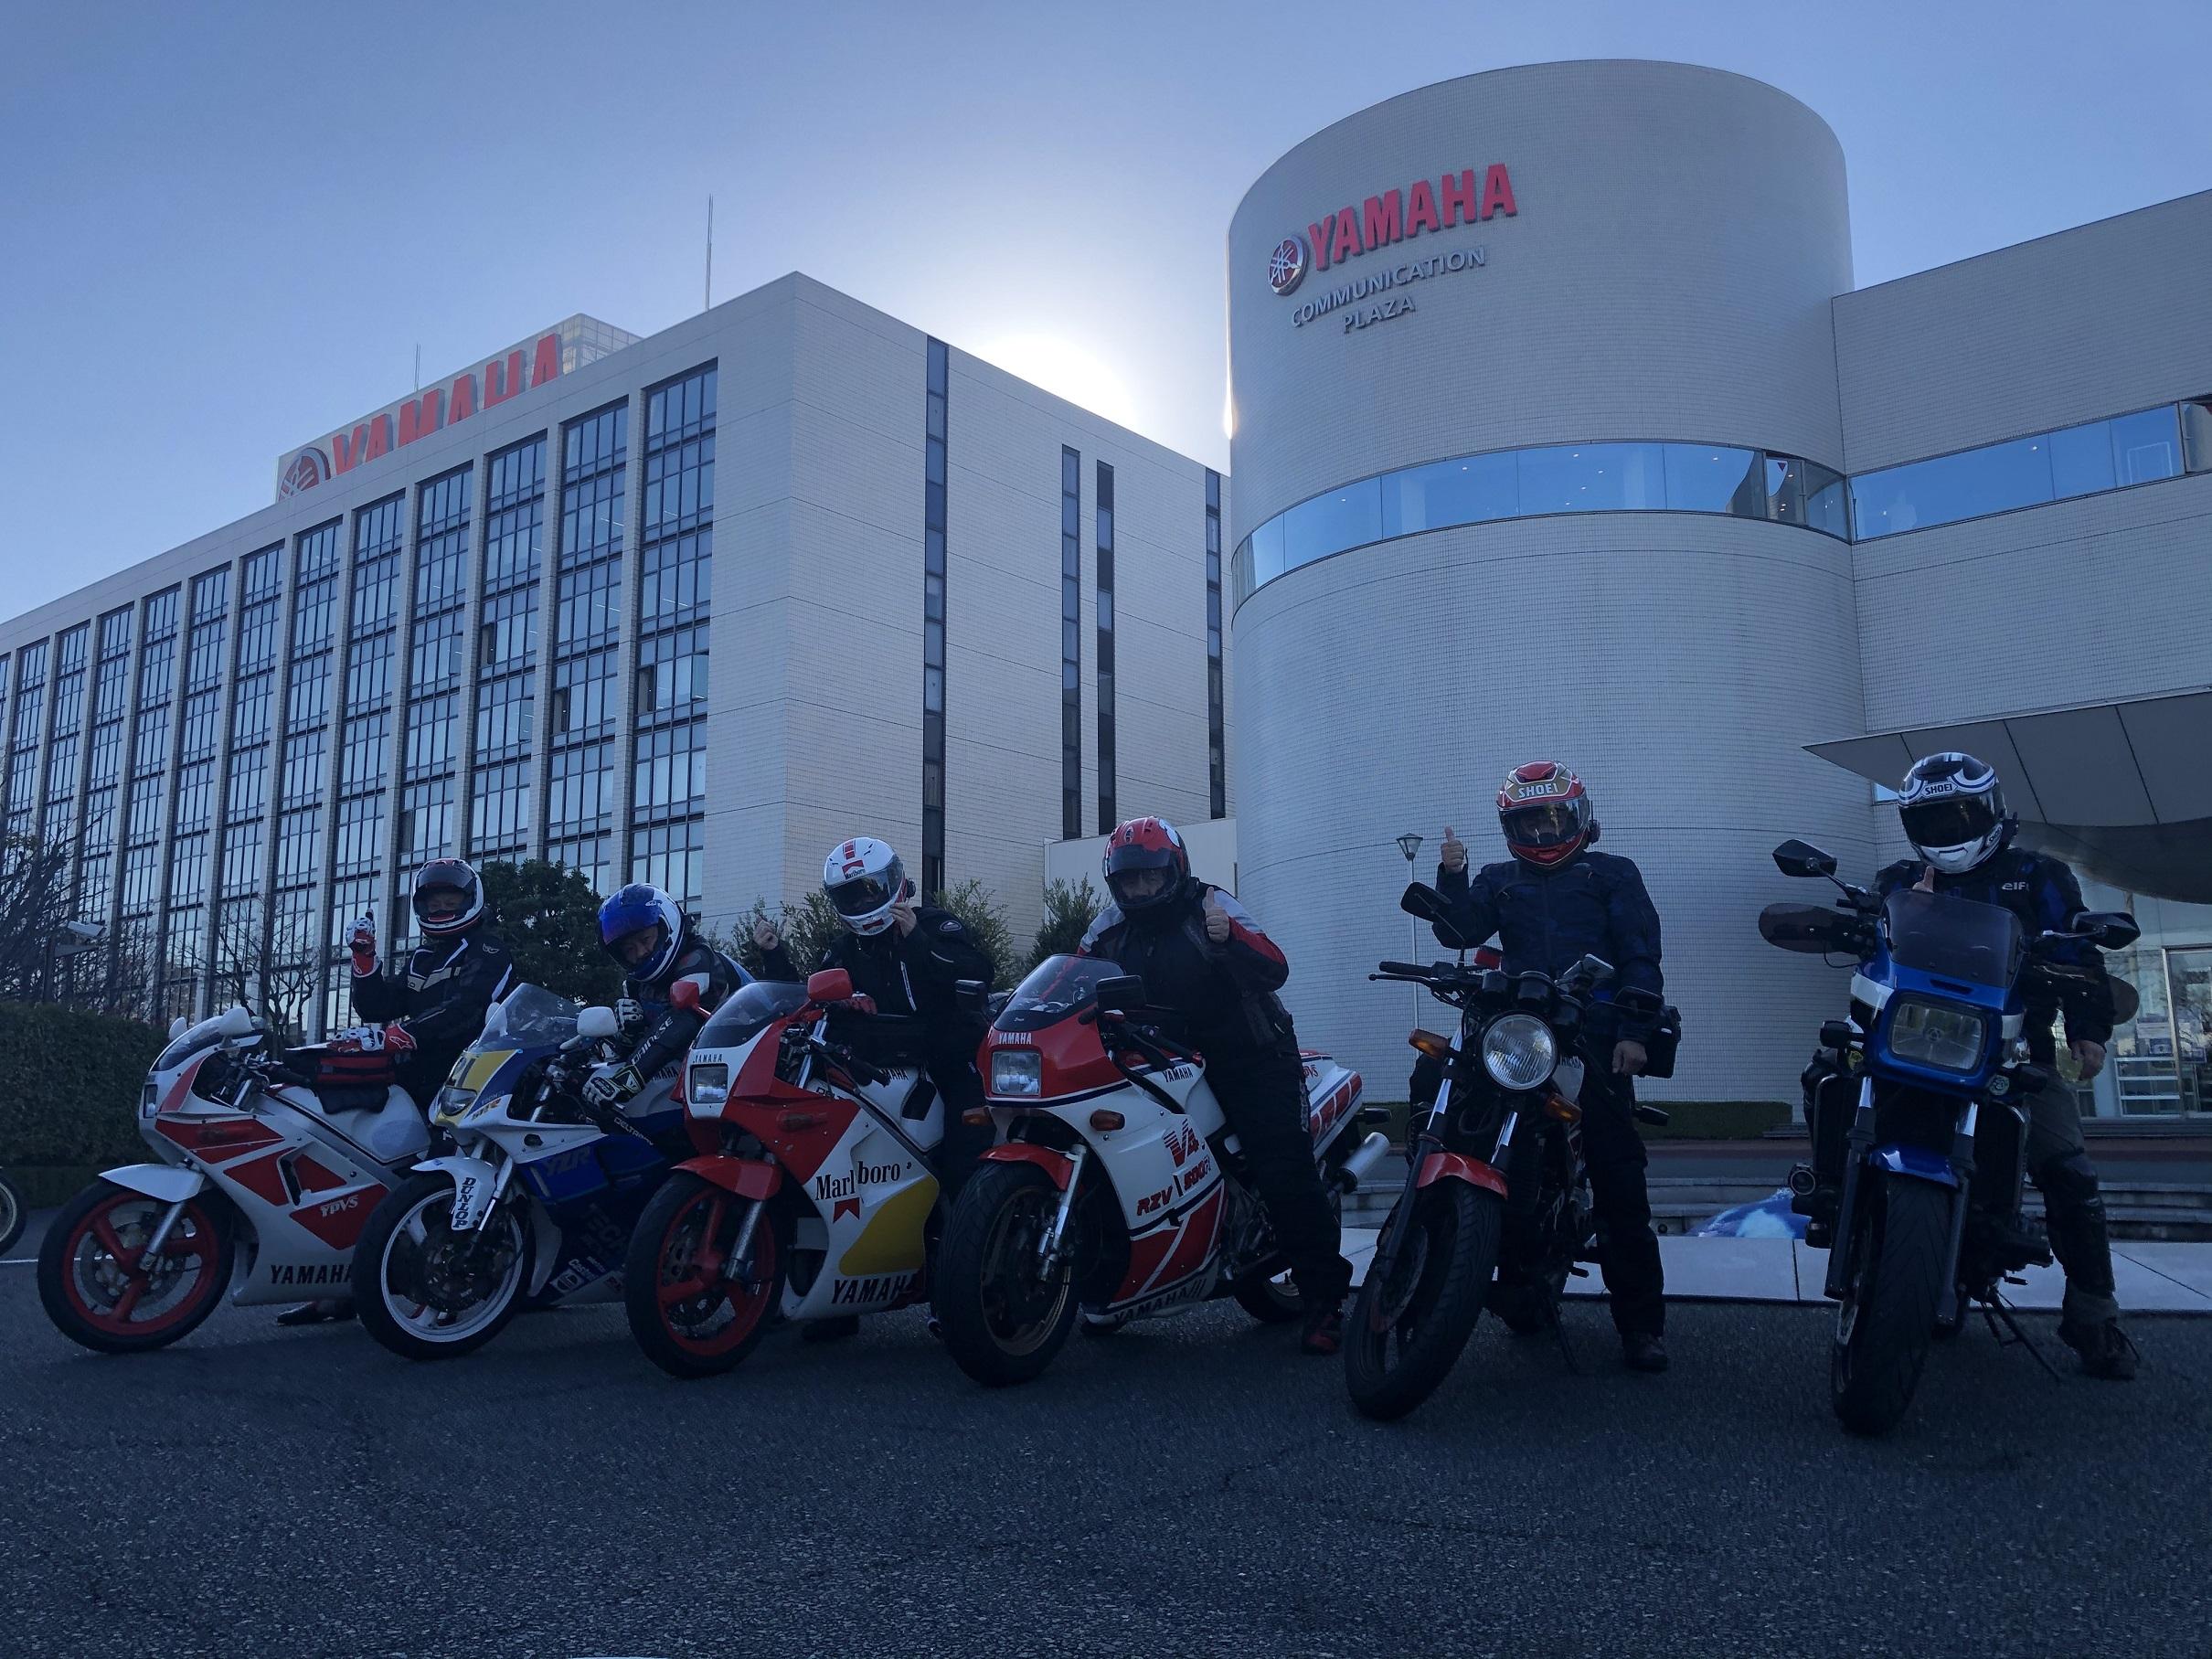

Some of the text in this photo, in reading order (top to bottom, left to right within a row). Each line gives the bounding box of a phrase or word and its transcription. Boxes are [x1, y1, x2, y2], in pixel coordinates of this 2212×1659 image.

[1308, 163, 1517, 271] YAMAHA
[1291, 247, 1485, 327] COMMUNICATION
[1344, 296, 1416, 333] PLAZA
[1518, 782, 1558, 799] SHOEI
[1925, 783, 1952, 795] SHOEI
[845, 868, 867, 880] Marlboro
[630, 1016, 675, 1066] DAINESE
[999, 1032, 1032, 1045] YAMAHA
[1163, 1066, 1194, 1083] YAMAHA
[815, 1160, 901, 1201] Marlboro
[319, 1194, 359, 1218] YPVS
[452, 1176, 477, 1228] DUNLOP
[1136, 1185, 1174, 1217] RZV
